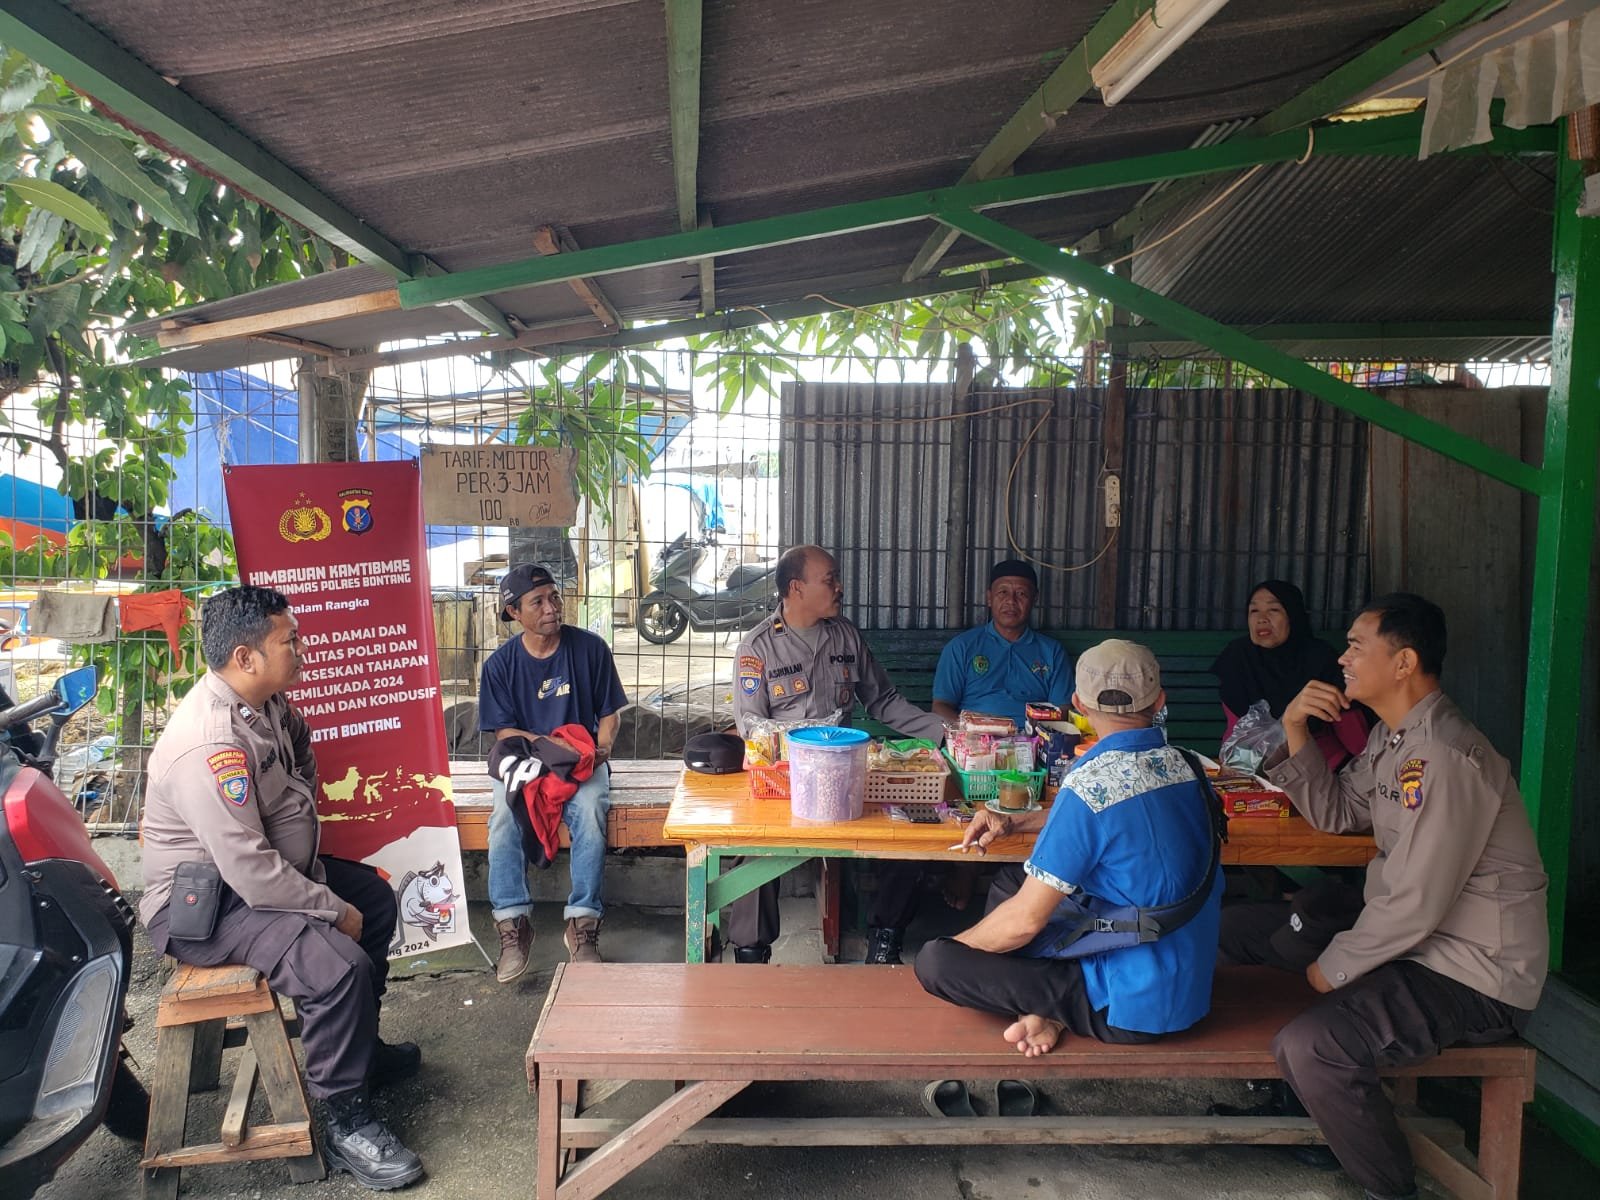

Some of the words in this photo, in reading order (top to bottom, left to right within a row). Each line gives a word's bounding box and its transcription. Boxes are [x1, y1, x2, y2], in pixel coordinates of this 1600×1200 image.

[492, 451, 550, 471] MOTOR
[512, 471, 551, 494] JAM
[479, 499, 503, 521] 100
[249, 566, 326, 586] HIMBAUAN
[329, 559, 411, 579] KAMTIBMAS
[321, 577, 361, 592] POLRES
[363, 573, 411, 587] BONTANG
[325, 598, 370, 613] Rangka
[332, 627, 376, 643] DAMAI
[378, 624, 407, 637] DAN
[347, 644, 387, 658] POLRI
[389, 639, 418, 653] DAN
[366, 654, 429, 673] TAHAPAN
[285, 679, 371, 702] PEMILUKADA
[374, 674, 404, 689] 2024
[555, 683, 570, 697] AIR
[338, 697, 367, 712] DAN
[369, 686, 437, 707] KONDUSIF
[310, 726, 338, 743] OTA
[341, 716, 402, 738] BONTANG
[404, 941, 430, 953] 2024
